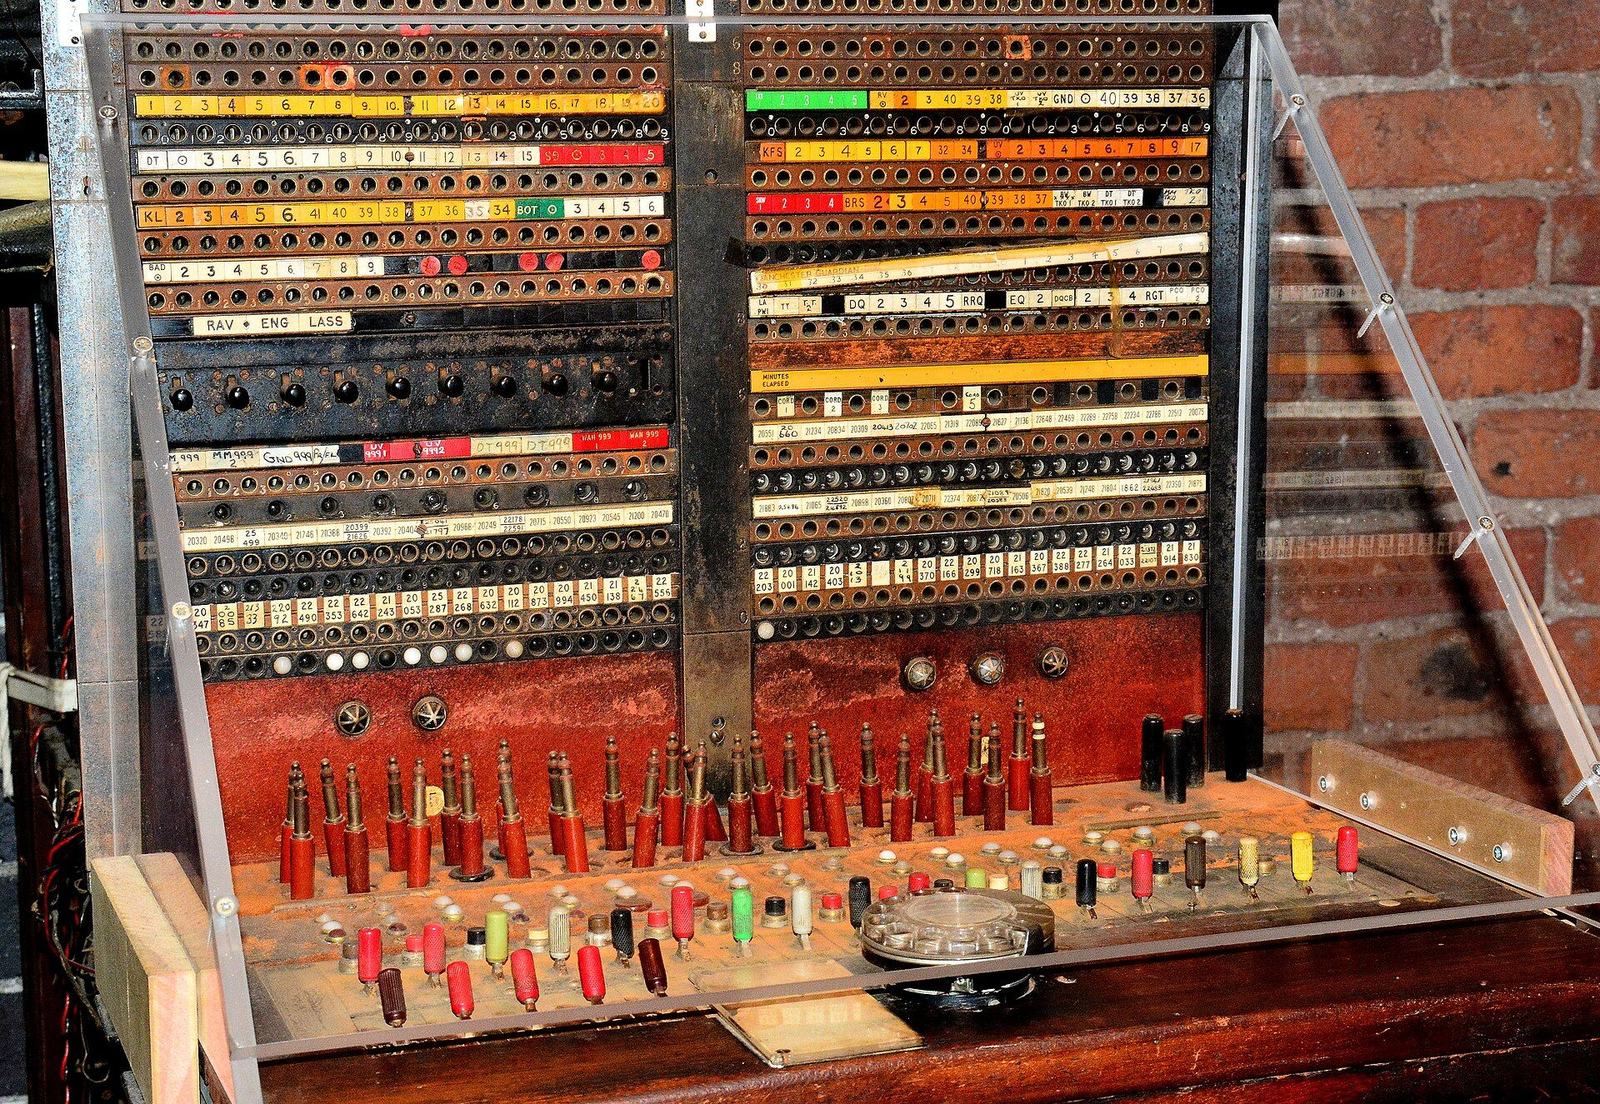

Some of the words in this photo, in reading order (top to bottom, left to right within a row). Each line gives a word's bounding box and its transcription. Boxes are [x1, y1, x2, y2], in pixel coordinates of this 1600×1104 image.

[901, 95, 909, 105] 2
[926, 96, 931, 104] 3
[944, 95, 956, 104] 40
[966, 95, 981, 105] 39
[990, 95, 1002, 104] 38
[1054, 94, 1074, 104] GND
[1100, 92, 1116, 105] 40
[1123, 94, 1138, 104] 39
[1146, 93, 1160, 102] 38
[1168, 93, 1182, 102] 37
[1191, 93, 1205, 102] 36
[149, 101, 152, 110] 1
[174, 100, 182, 110] 2
[201, 100, 208, 110] 3
[228, 99, 236, 112] 4
[255, 100, 263, 110] 5
[308, 101, 314, 110] 7
[335, 101, 341, 109] 8
[422, 99, 429, 111] 11
[444, 99, 456, 110] 12
[496, 99, 506, 109] 14
[521, 99, 531, 109] 15
[763, 146, 783, 157] KFS
[795, 146, 802, 157] 2
[819, 147, 825, 157] 3
[841, 145, 850, 157] 4
[866, 147, 871, 155] 5
[916, 146, 921, 155] 7
[962, 145, 972, 155] 34
[1017, 145, 1024, 154] 2
[1039, 145, 1046, 154] 3
[1061, 145, 1068, 154] 4
[1084, 144, 1091, 154] 5
[1127, 143, 1133, 152] 7
[1149, 143, 1156, 152] 8
[1172, 141, 1178, 153] 9
[1190, 143, 1200, 152] 17
[147, 156, 159, 165] DT
[204, 152, 215, 166] 3
[232, 154, 241, 165] 4
[258, 152, 268, 166] 5
[312, 153, 319, 163] 7
[340, 153, 346, 162] 8
[366, 151, 372, 161] 9
[391, 150, 401, 162] 10
[420, 152, 425, 162] 11
[444, 152, 454, 163] 12
[495, 151, 507, 161] 14
[522, 151, 532, 161] 15
[829, 198, 834, 208] 4
[845, 197, 864, 207] BRS
[874, 195, 882, 209] 2
[897, 194, 906, 209] 3
[919, 196, 927, 205] 4
[944, 197, 950, 206] 5
[964, 195, 977, 205] 40
[991, 195, 1004, 205] 39
[1013, 195, 1026, 204] 38
[1036, 194, 1047, 204] 37
[144, 211, 162, 222] KL
[175, 211, 184, 222] 2
[204, 211, 212, 222] 3
[230, 211, 239, 220] 4
[256, 208, 265, 222] 5
[333, 207, 347, 218] 40
[385, 207, 398, 217] 38
[420, 206, 432, 216] 37
[445, 205, 458, 215] 36
[493, 205, 510, 215] 34
[517, 205, 538, 215] BOT
[574, 204, 582, 214] 3
[598, 203, 605, 213] 4
[622, 201, 630, 211] 5
[180, 267, 189, 277] 2
[208, 266, 215, 277] 3
[234, 265, 242, 275] 4
[260, 264, 268, 275] 5
[340, 262, 347, 273] 8
[849, 300, 865, 309] DQ
[877, 299, 884, 308] 2
[900, 297, 907, 307] 3
[924, 297, 931, 307] 4
[946, 296, 955, 307] 5
[963, 297, 983, 306] RRQ
[1010, 296, 1025, 304] EQ
[1037, 294, 1044, 303] 2
[1084, 293, 1091, 302] 2
[1129, 291, 1136, 300] 4
[1146, 291, 1163, 300] RGT
[207, 320, 234, 331] RAV
[261, 318, 288, 328] ENG
[309, 316, 343, 327] LASS
[969, 398, 976, 409] 5
[1078, 550, 1088, 558] 22
[990, 556, 1000, 564] 20
[1076, 561, 1090, 569] 277
[783, 570, 794, 578] 20
[829, 567, 840, 575] 20
[988, 566, 1001, 575] 718
[758, 572, 769, 580] 22
[919, 572, 935, 580] 370
[756, 583, 772, 591] 203
[781, 581, 795, 590] 001
[827, 578, 843, 587] 403
[483, 589, 494, 598] 20
[508, 587, 520, 596] 20
[354, 597, 365, 606] 22
[406, 594, 418, 603] 20
[328, 600, 339, 608] 22
[480, 601, 497, 610] 632
[508, 599, 520, 608] 112
[352, 609, 368, 619] 642
[404, 606, 421, 615] 053
[326, 611, 343, 620] 353
